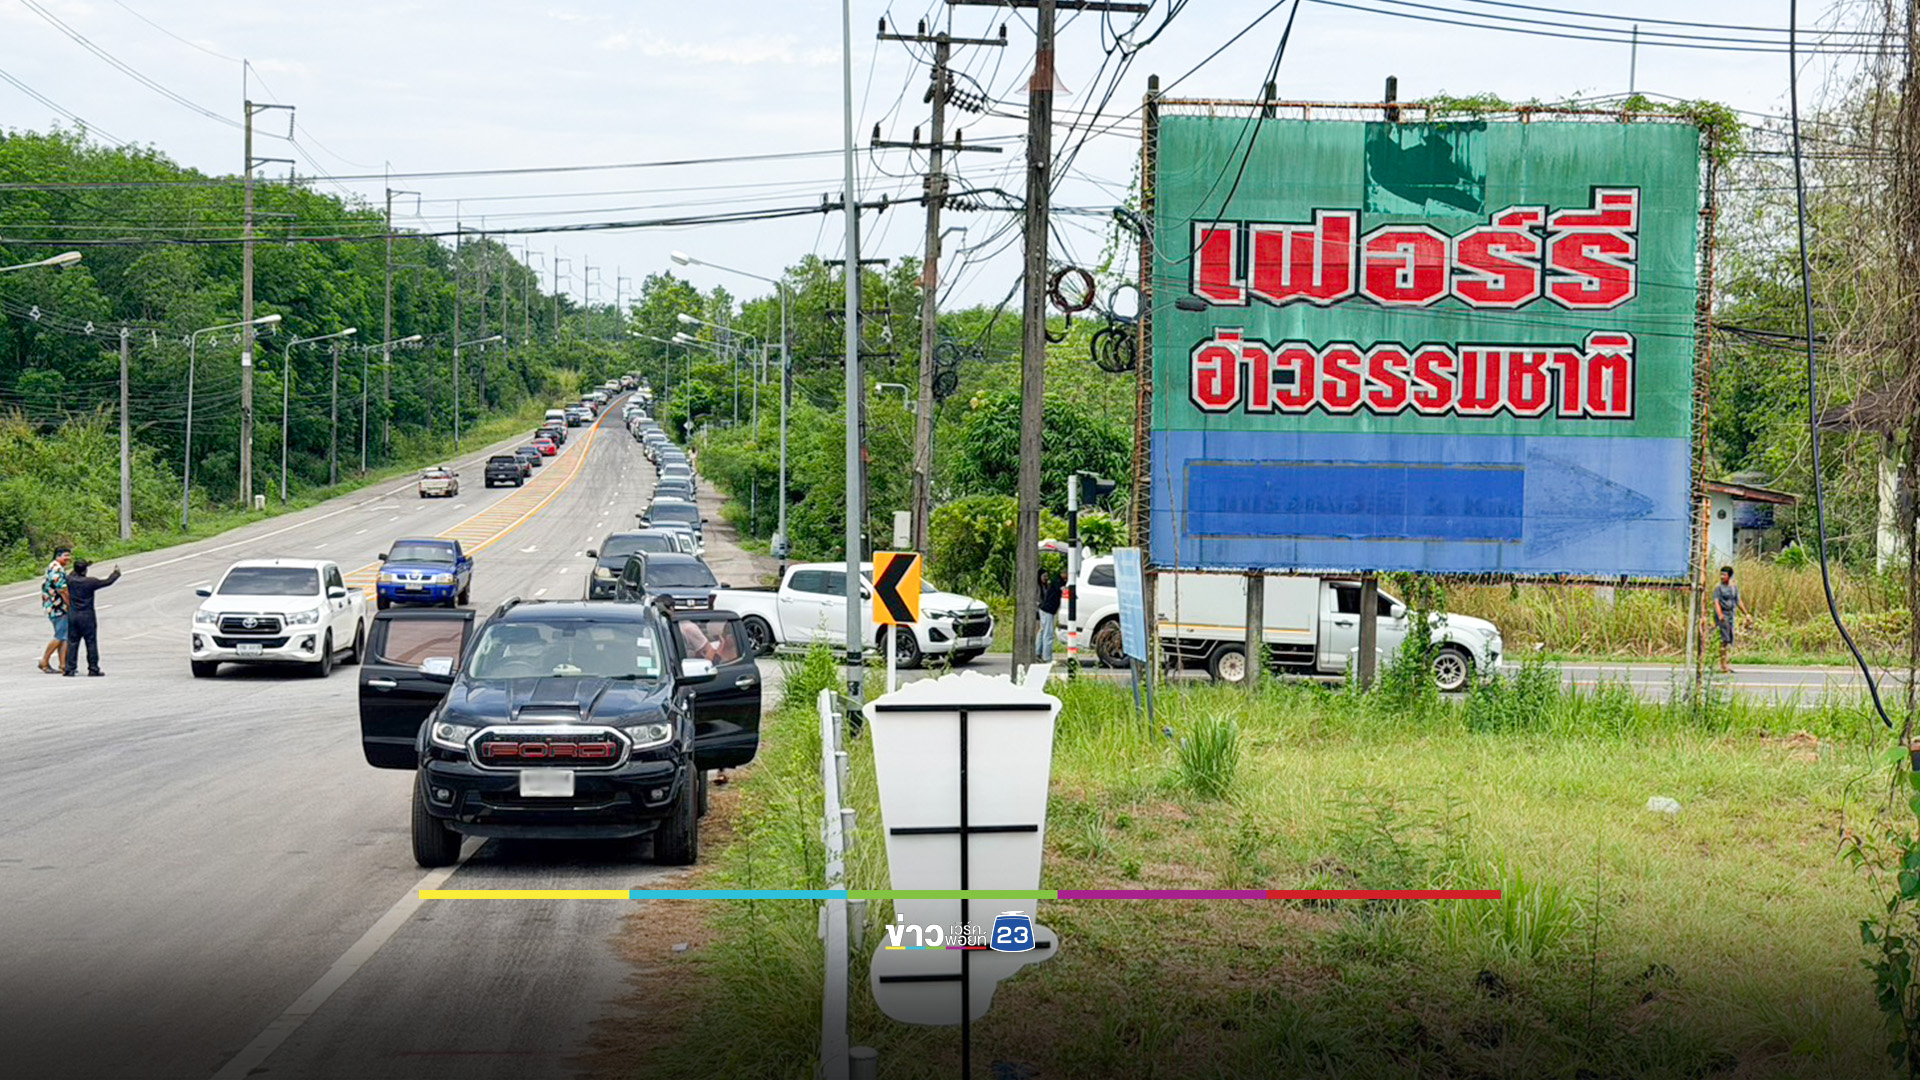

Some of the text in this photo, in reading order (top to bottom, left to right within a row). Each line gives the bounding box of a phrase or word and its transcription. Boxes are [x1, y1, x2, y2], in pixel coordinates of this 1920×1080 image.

[1190, 185, 1640, 311] เฟอร์รี่
[1189, 326, 1635, 420] อ่าวธรรมชาติ
[482, 741, 618, 758] FORD
